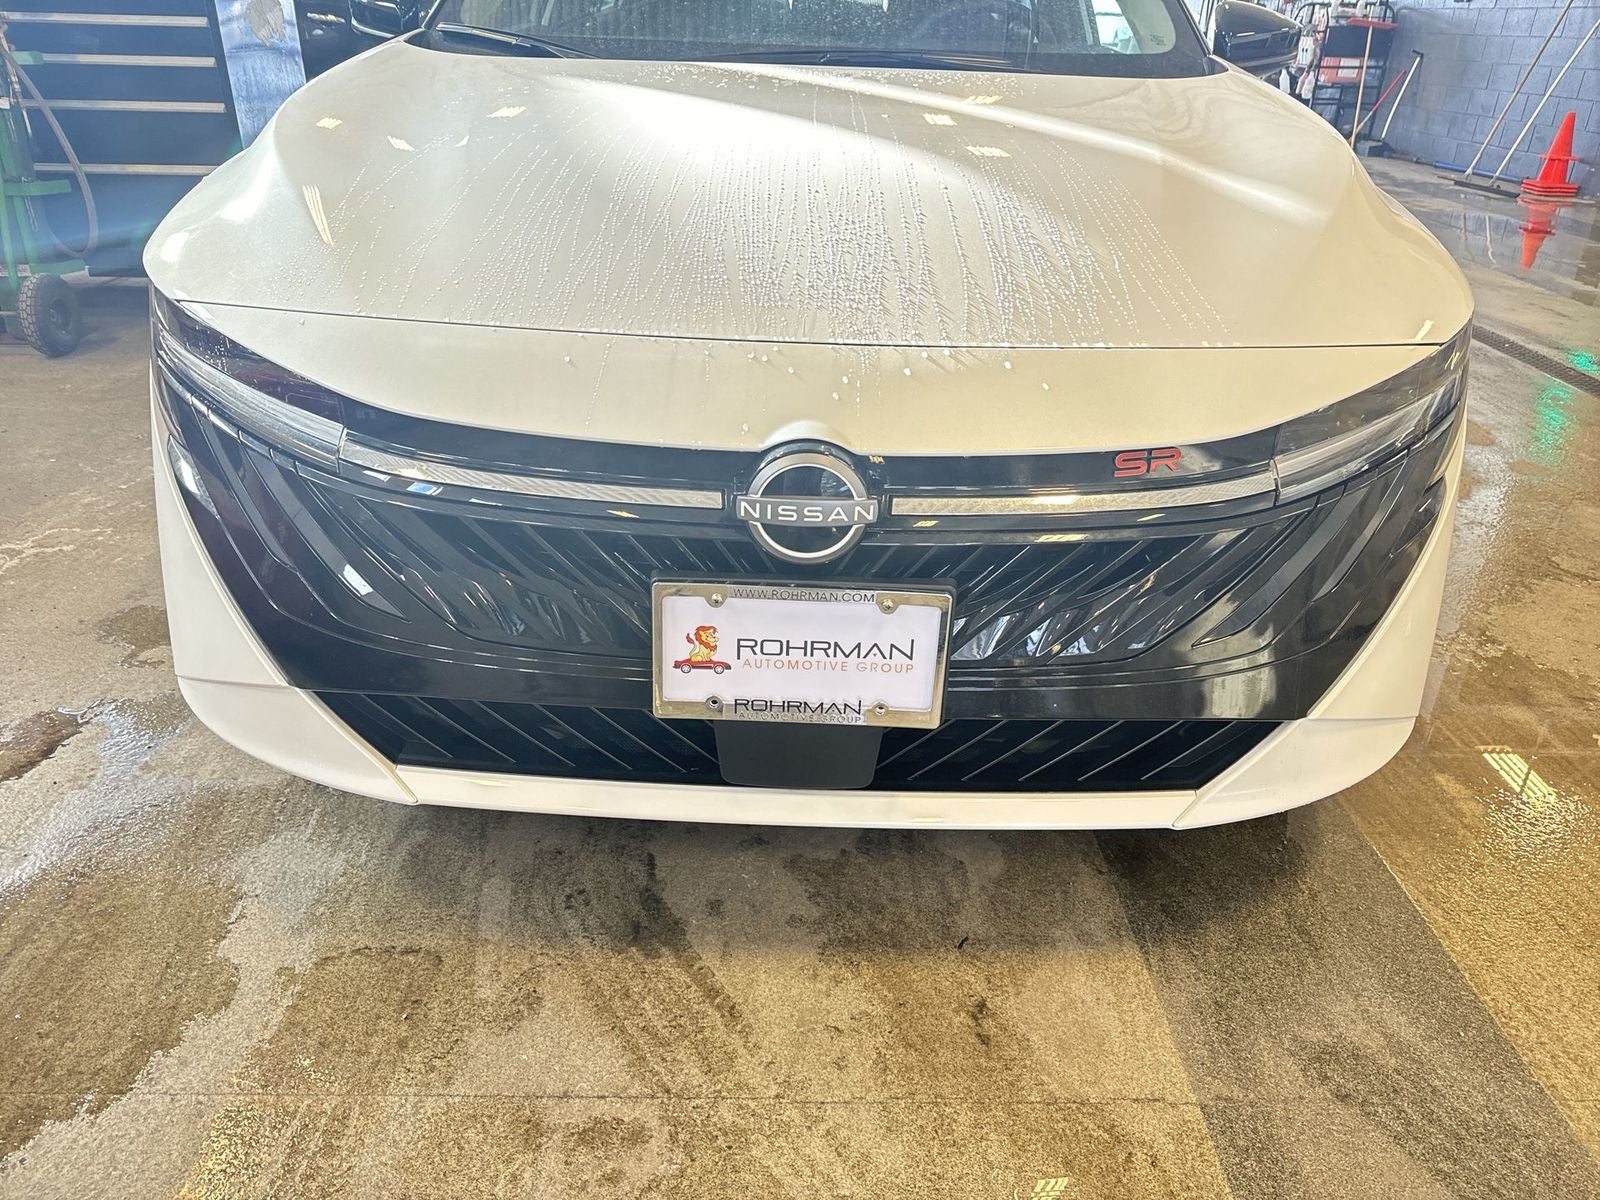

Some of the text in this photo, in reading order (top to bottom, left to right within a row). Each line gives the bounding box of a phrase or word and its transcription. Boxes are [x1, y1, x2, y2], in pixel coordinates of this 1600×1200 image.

[1114, 448, 1181, 478] SR
[740, 501, 874, 522] NISSAN
[733, 588, 875, 603] WWW.ROHRMAN.COM
[736, 637, 915, 661] ROHRMAN
[742, 659, 914, 674] AUTOMOTIVE GROUP
[734, 698, 861, 716] ROHRMAN
[738, 711, 862, 724] AUTOMOTIVE GROUP
